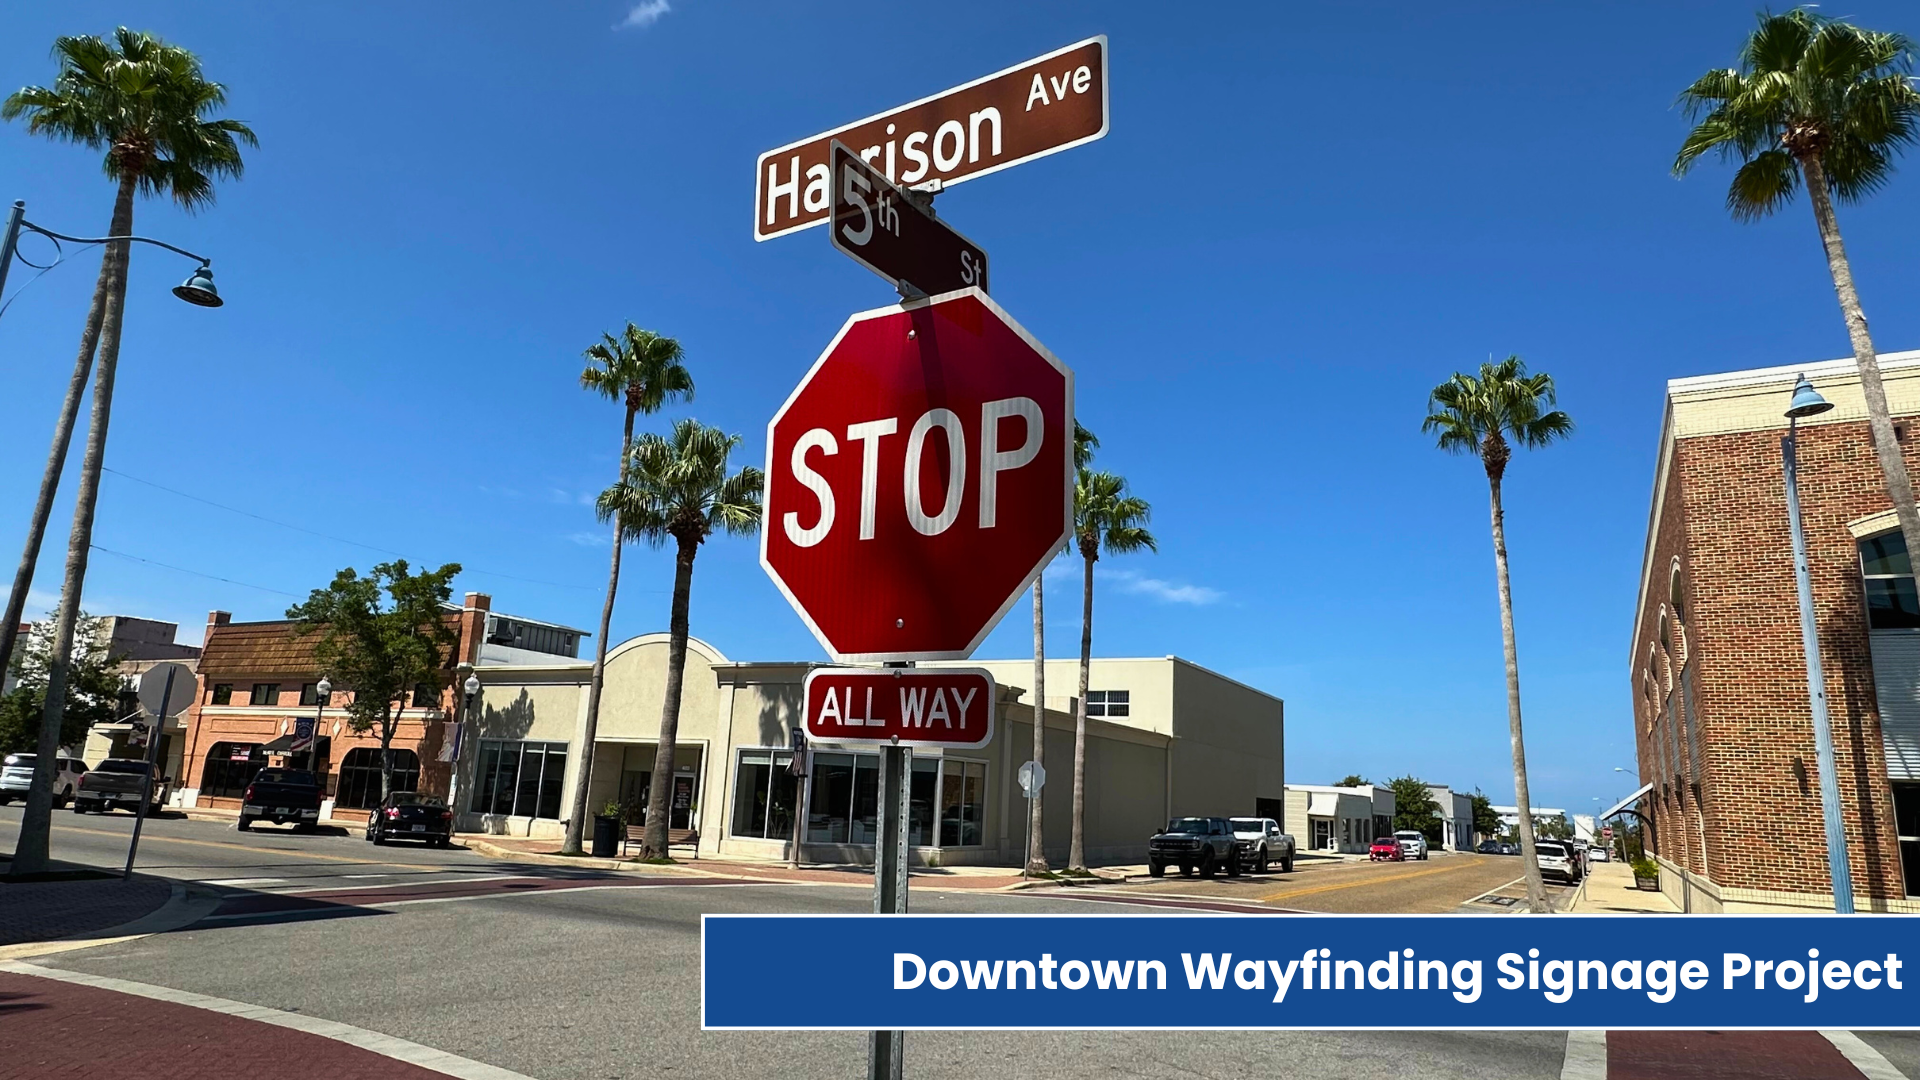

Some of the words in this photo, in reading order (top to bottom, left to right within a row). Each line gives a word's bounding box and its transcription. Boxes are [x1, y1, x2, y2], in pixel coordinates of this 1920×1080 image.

[1025, 64, 1092, 112] Ave
[841, 163, 900, 247] 5th
[960, 250, 982, 287] St
[783, 396, 1044, 548] STOP
[817, 686, 886, 727] ALL
[900, 687, 978, 729] WAY
